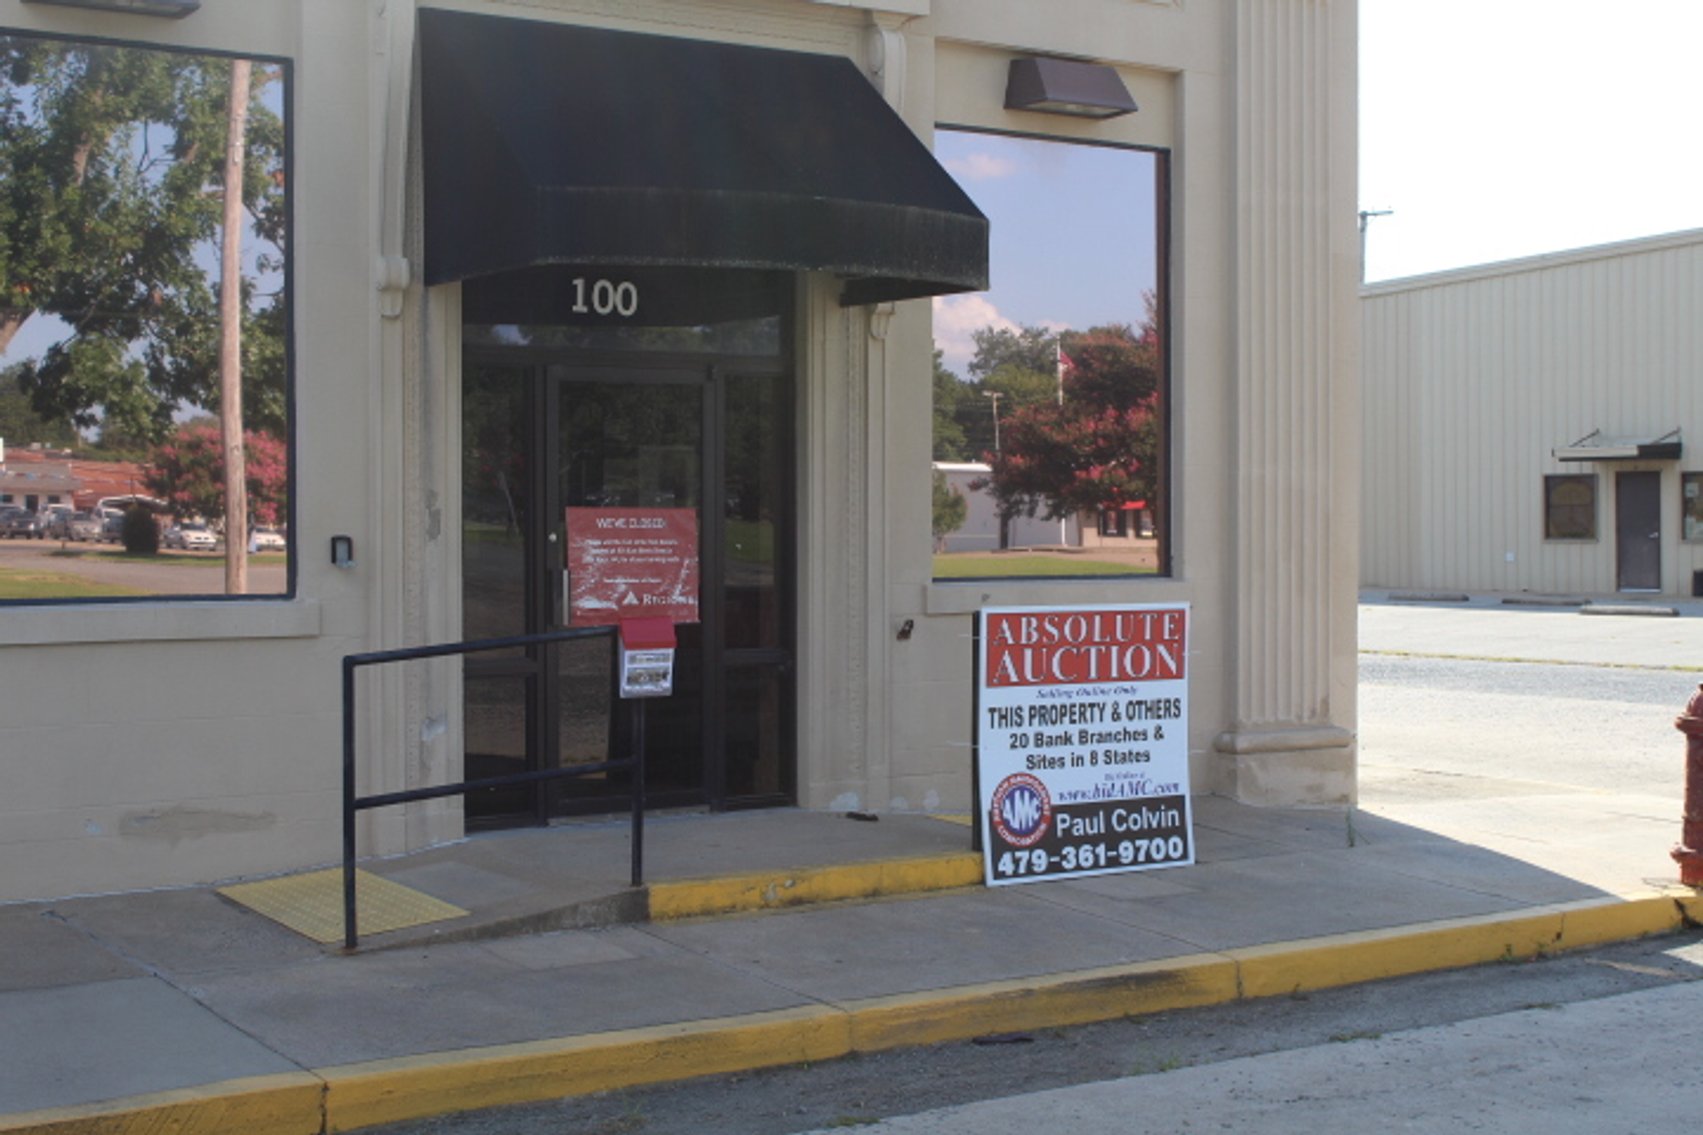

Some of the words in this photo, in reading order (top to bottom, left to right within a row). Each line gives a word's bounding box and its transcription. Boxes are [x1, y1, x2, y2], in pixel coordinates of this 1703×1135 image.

[572, 278, 638, 316] 100
[993, 612, 1180, 646] ABSOLUTE
[993, 642, 1179, 684] AUCTION
[988, 705, 1024, 729] THIS
[1028, 702, 1106, 727] PROPERTY
[1111, 700, 1122, 722] &
[1125, 698, 1181, 721] OTHERS
[1010, 733, 1030, 749] 20
[1034, 731, 1074, 748] Bank
[1078, 727, 1148, 746] Branches
[1153, 724, 1164, 741] &
[1026, 754, 1065, 770] Sites
[1071, 752, 1084, 768] in
[1090, 750, 1098, 766] 8
[1104, 749, 1151, 766] States
[1003, 789, 1041, 831] AMC
[1056, 811, 1105, 838] Paul
[1111, 805, 1181, 832] Colvin
[998, 836, 1184, 876] 479-361-9700
